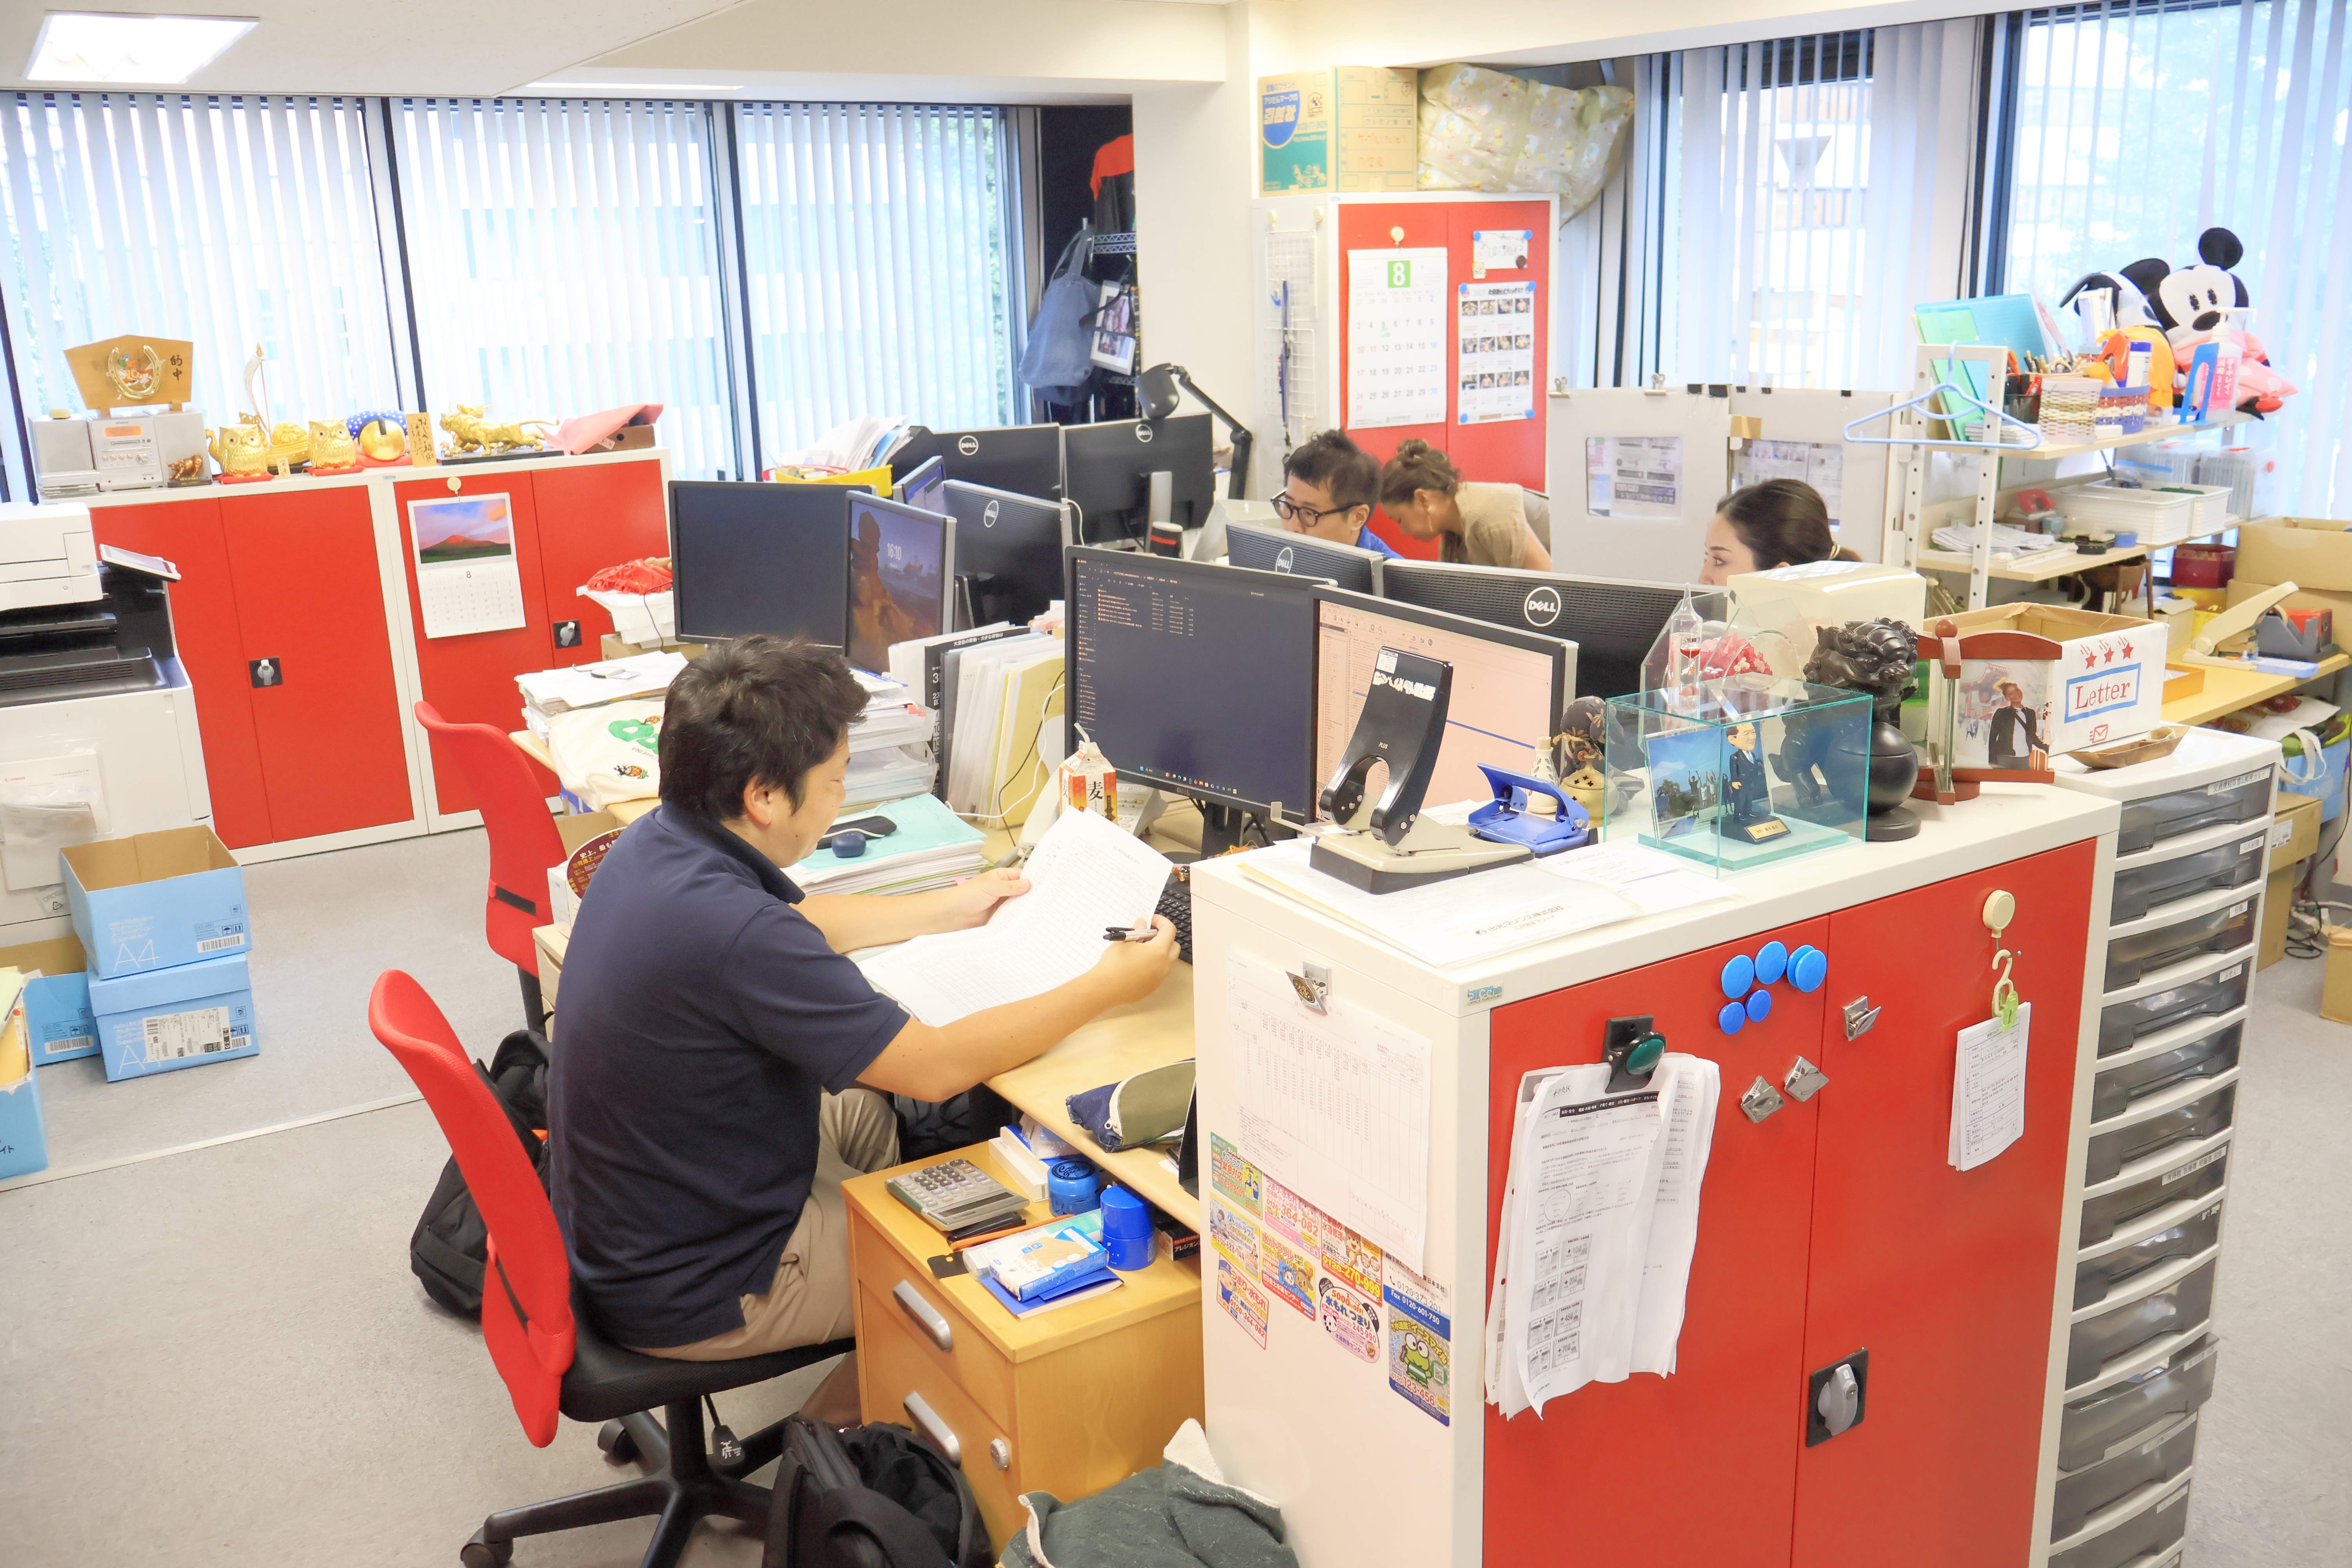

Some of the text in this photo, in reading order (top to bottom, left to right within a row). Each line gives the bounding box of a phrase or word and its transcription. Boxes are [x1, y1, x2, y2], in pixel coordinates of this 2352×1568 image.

[1393, 262, 1406, 286] 8
[170, 354, 183, 382] 的中
[887, 543, 902, 560] 16:10
[1528, 600, 1556, 613] DELL
[954, 633, 1004, 647] 大至急の荷物・大きな荷物は
[2075, 681, 2131, 710] Letter
[1087, 781, 1103, 801] 麦
[114, 939, 160, 973] A4
[1557, 1085, 1571, 1095] 中央区
[1222, 1151, 1244, 1171] 水のトラブル
[1222, 1161, 1243, 1182] 緊急対応
[1266, 1180, 1298, 1205] つまり・水もれ
[1227, 1210, 1255, 1240] 水のトラブル
[1267, 1198, 1318, 1238] 0120-364-082
[1322, 1221, 1343, 1242] 水道修理
[1217, 1235, 1245, 1261] 0120-688-744
[1262, 1232, 1294, 1261] 水のトラブル
[1294, 1253, 1303, 1262] 水もれ
[1322, 1242, 1350, 1265] 水道総合サービス
[1322, 1255, 1381, 1298] 0120-270-999
[1423, 1274, 1445, 1293] 東日本支社
[1231, 1270, 1266, 1311] つまり・水もれ
[1331, 1289, 1364, 1315] 5000円OFF!
[1397, 1281, 1441, 1314] 0120-373-201
[1230, 1298, 1265, 1338] 0120-364-082
[1391, 1289, 1400, 1301] Fax
[1402, 1295, 1440, 1325] 0120-601-750
[1343, 1318, 1376, 1343] 0120-245-990
[1412, 1324, 1448, 1365] イースマイル
[1391, 1372, 1435, 1406] 0120-123-456
[1437, 1404, 1447, 1414] 2680
